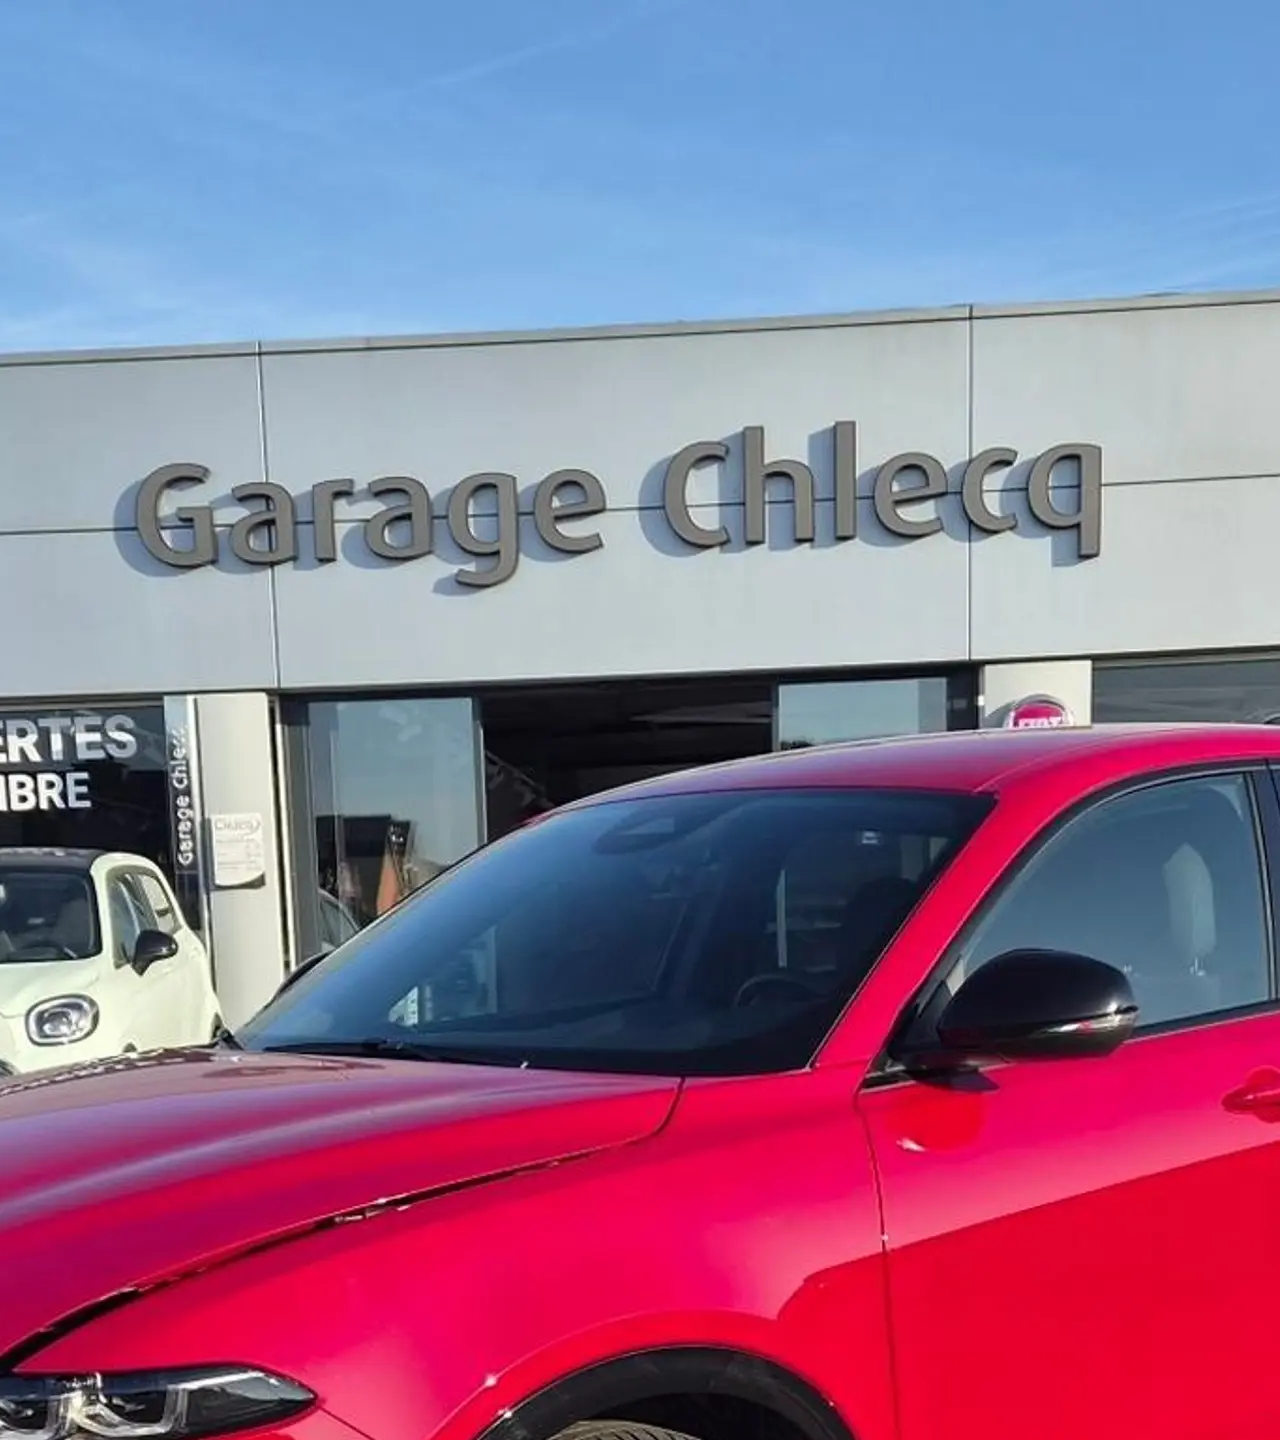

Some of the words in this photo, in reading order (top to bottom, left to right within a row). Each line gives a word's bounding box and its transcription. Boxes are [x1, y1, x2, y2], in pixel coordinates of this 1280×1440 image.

[137, 462, 606, 587] Garage
[663, 421, 1101, 559] Chlecq
[177, 795, 194, 865] Garage
